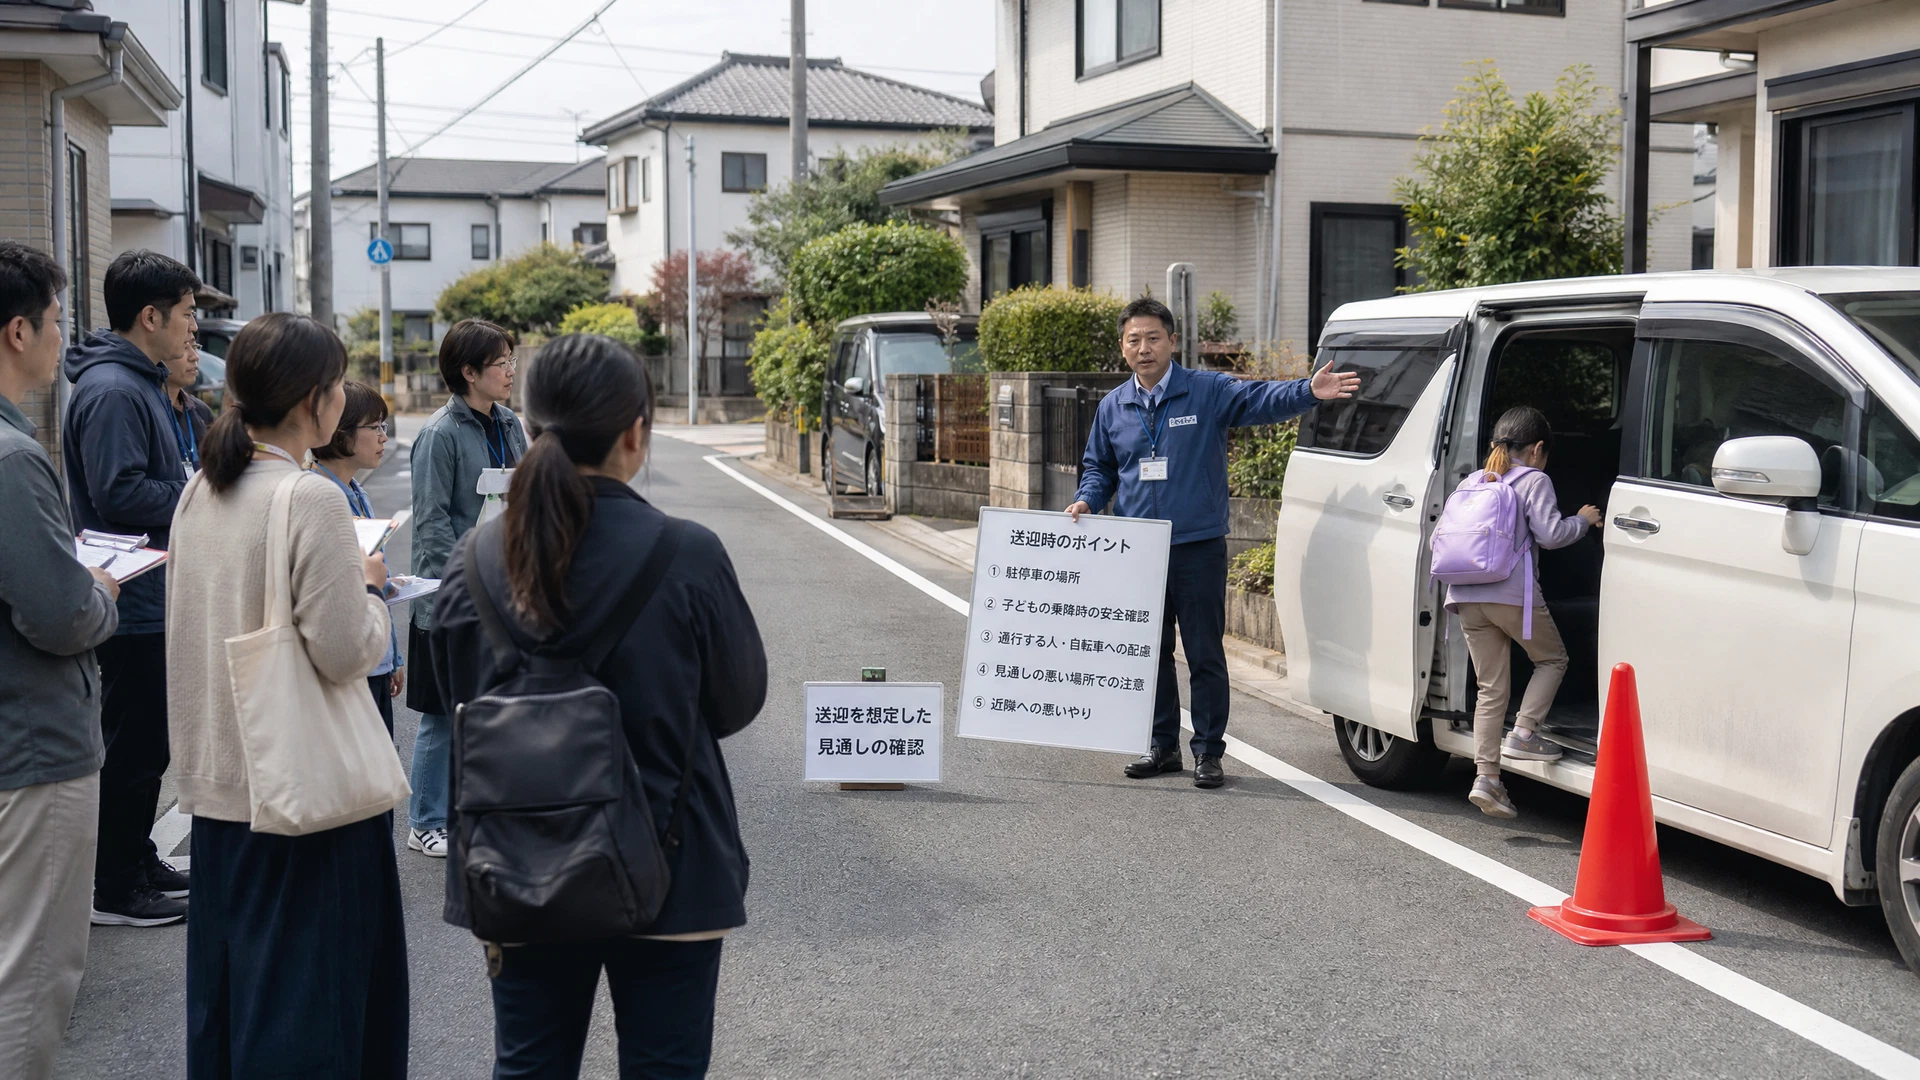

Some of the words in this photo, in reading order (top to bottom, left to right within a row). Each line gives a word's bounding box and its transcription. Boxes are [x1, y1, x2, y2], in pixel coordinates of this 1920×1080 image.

[1009, 529, 1131, 554] 送迎時のポイント
[1005, 566, 1081, 585] 駐停車の場所
[1001, 598, 1150, 624] 子どもの乗降時の安全確認
[997, 631, 1152, 658] 通行する人・自転車への配慮
[994, 664, 1146, 692] 見通しの悪い場所での注意
[815, 706, 932, 724] 送迎を想定した
[817, 738, 925, 756] 見通しの確認
